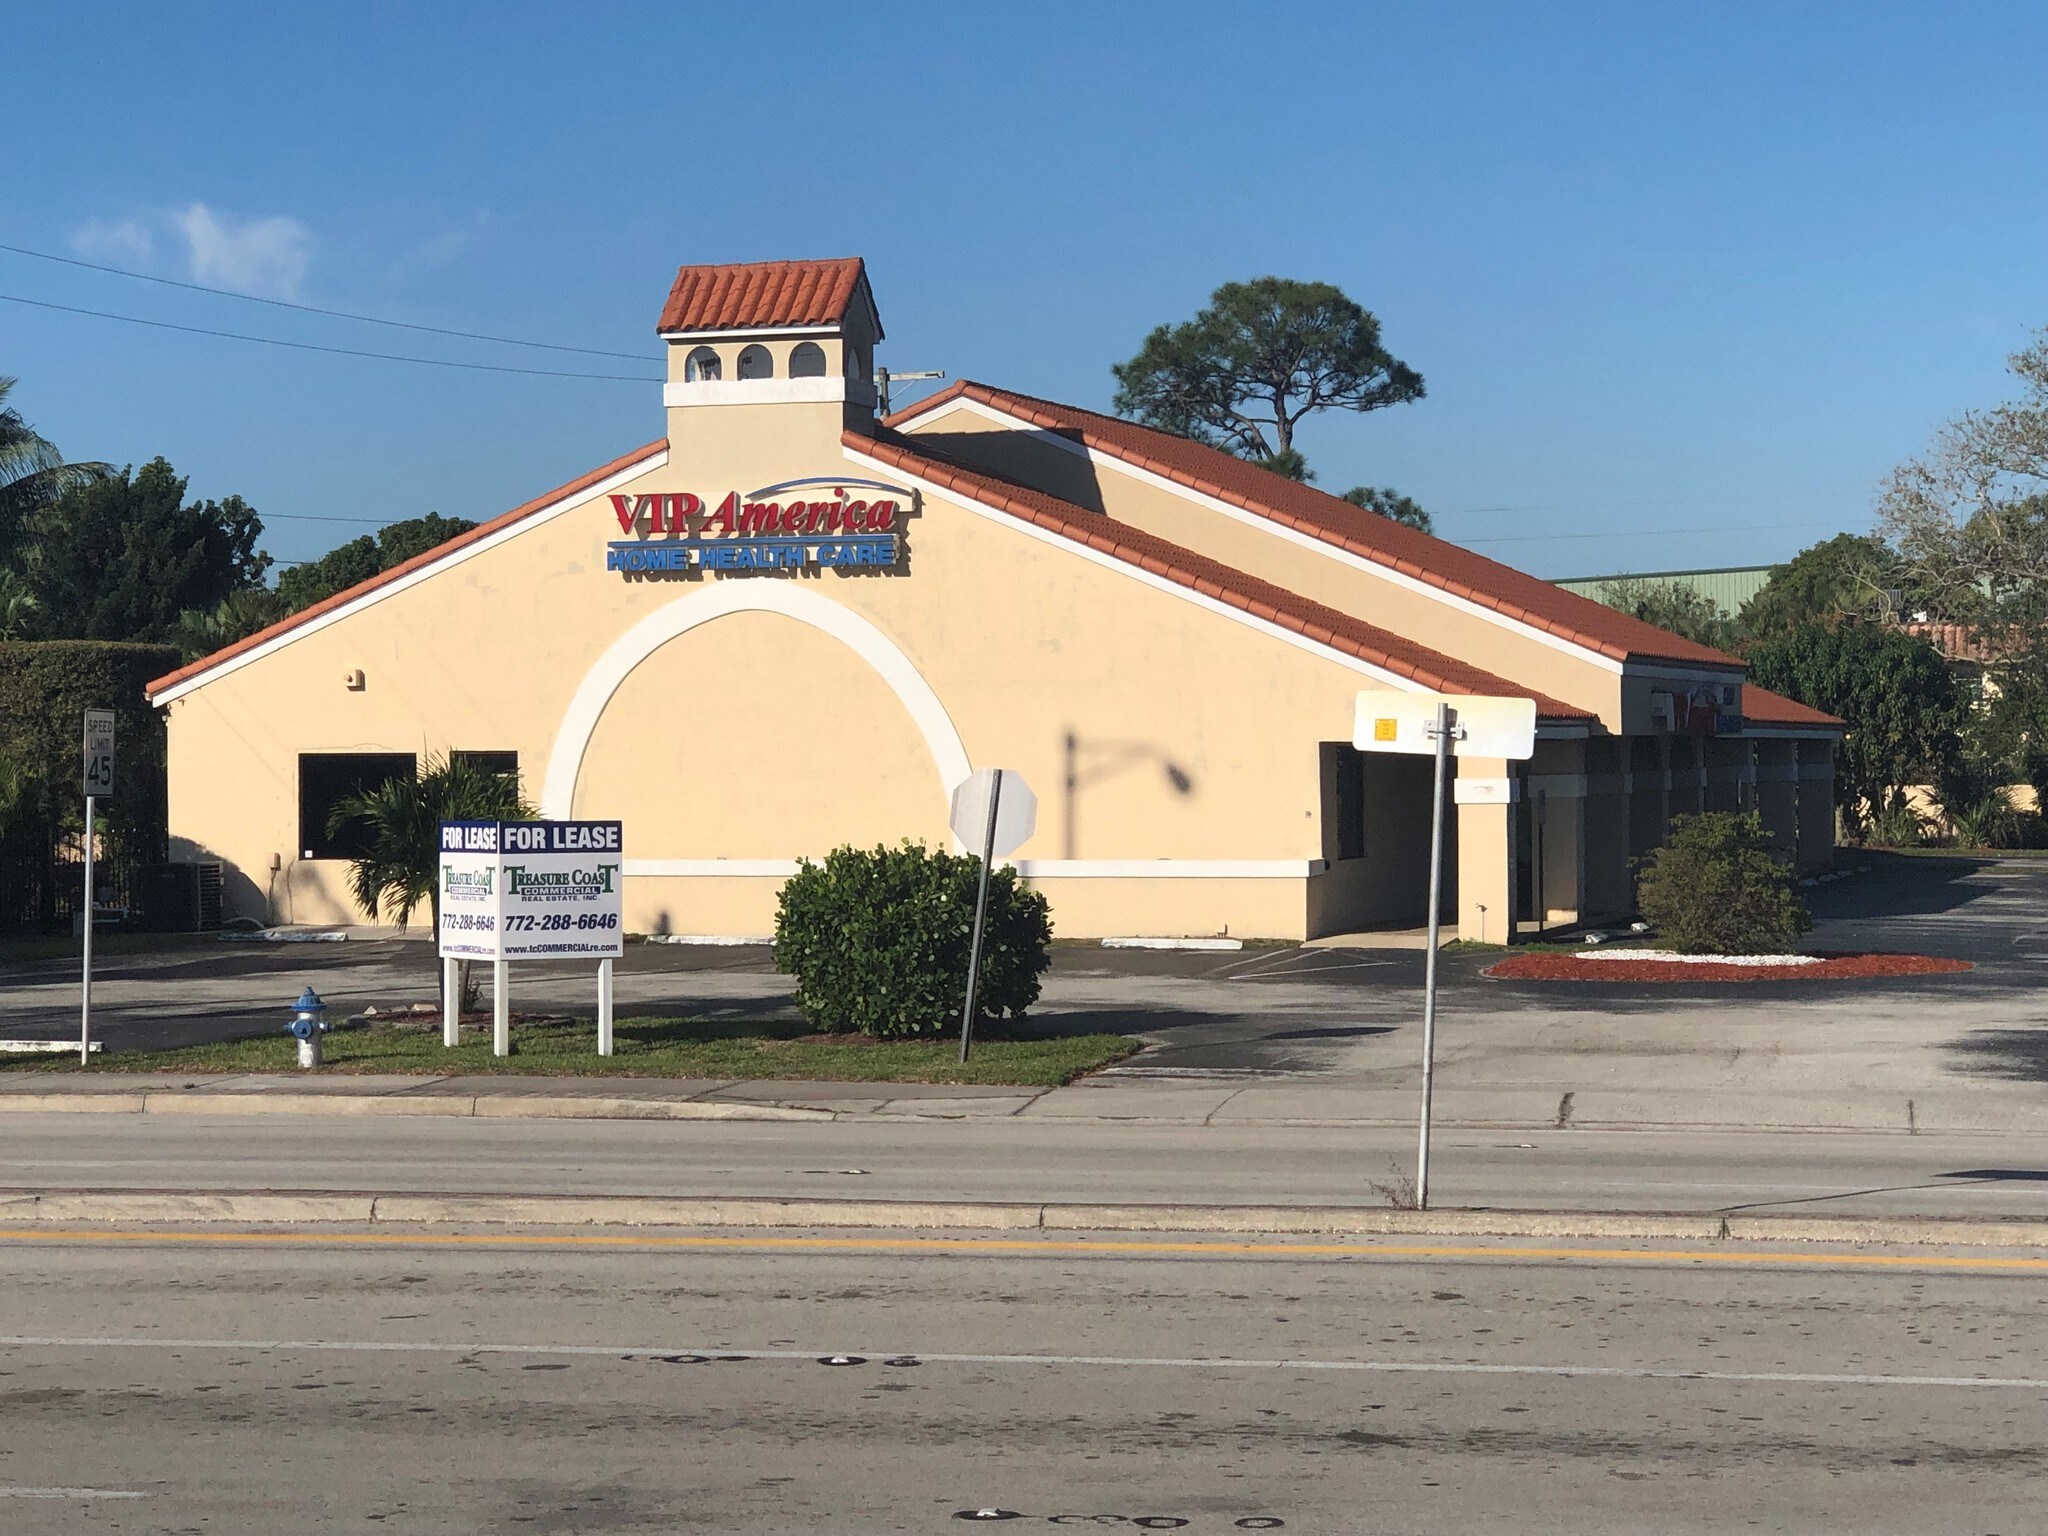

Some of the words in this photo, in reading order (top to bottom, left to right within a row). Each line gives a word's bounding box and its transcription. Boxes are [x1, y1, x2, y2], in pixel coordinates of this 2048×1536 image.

[607, 493, 700, 535] VIP
[701, 488, 895, 532] America
[607, 549, 688, 571] HOME
[700, 546, 806, 570] HEALTH
[817, 544, 896, 568] CARE
[88, 720, 112, 733] SPEED
[90, 738, 110, 750] LIMIT
[88, 756, 111, 786] 45
[442, 827, 461, 849] FOR
[465, 827, 497, 850] LEASE
[504, 827, 547, 850] FOR
[553, 826, 619, 849] LEASE
[442, 865, 472, 893] TREASURE
[473, 866, 496, 894] COAST
[503, 864, 570, 895] TREASURE
[571, 864, 619, 893] COAST
[451, 887, 486, 895] COMMERCIAL
[524, 887, 598, 895] COMMERCIAL
[442, 913, 495, 931] 772-288-6646
[505, 913, 618, 932] 772-288-6646
[504, 943, 618, 955] www.tcCOMMERCIALre.com
